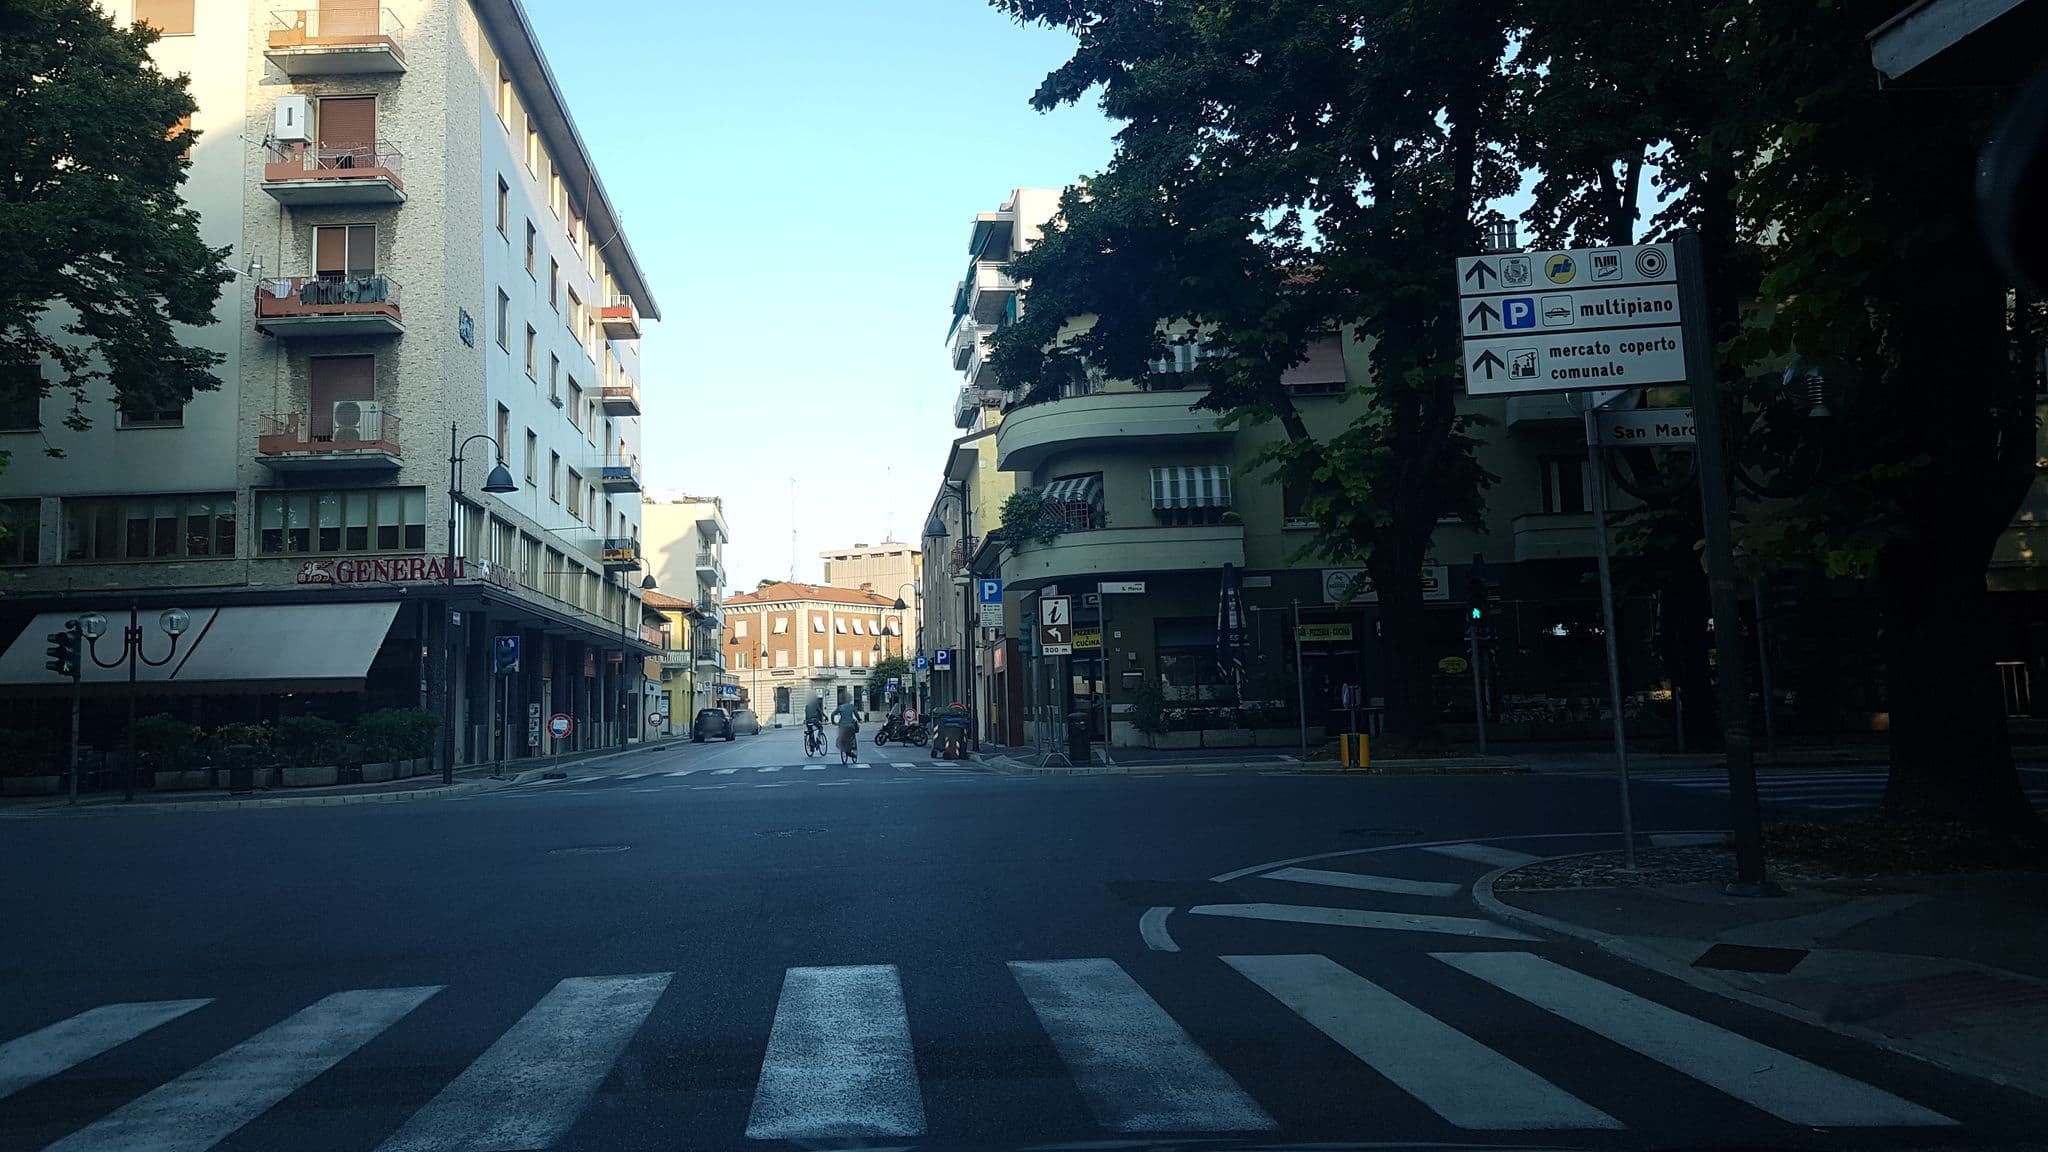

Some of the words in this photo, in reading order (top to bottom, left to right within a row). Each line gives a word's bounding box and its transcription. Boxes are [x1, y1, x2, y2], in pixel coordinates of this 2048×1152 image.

[1510, 302, 1529, 326] P
[1580, 297, 1673, 318] multipiano
[1549, 340, 1611, 358] mercato
[1619, 336, 1676, 357] coperto
[1550, 362, 1625, 380] comunale
[1613, 426, 1646, 439] San
[1655, 423, 1696, 437] Marc
[336, 556, 466, 583] GENERALI
[984, 582, 998, 600] P
[917, 658, 925, 667] P
[937, 651, 947, 663] P
